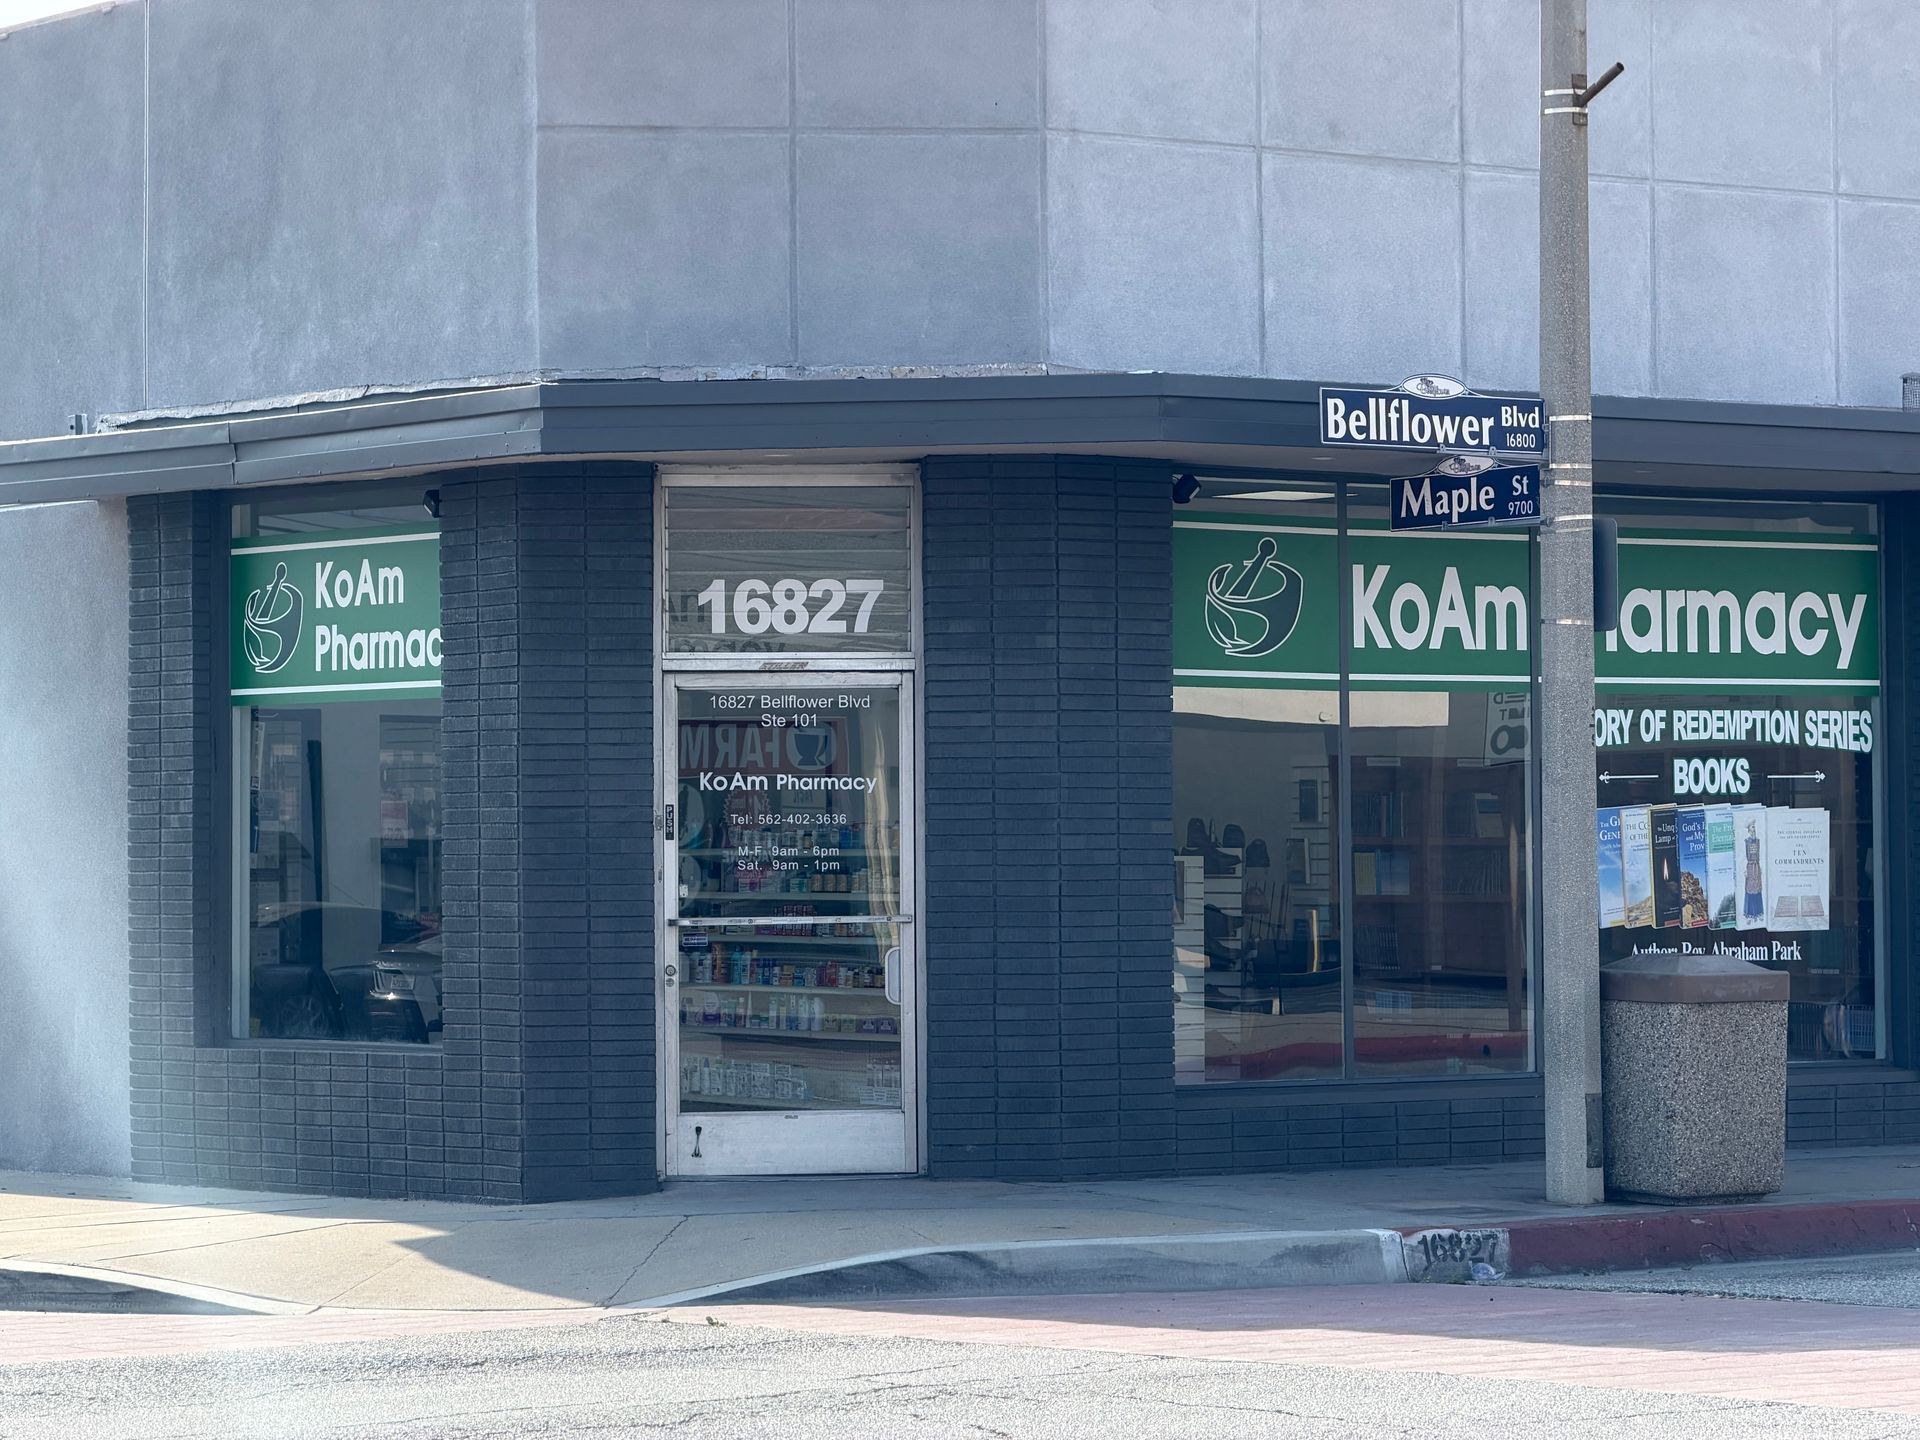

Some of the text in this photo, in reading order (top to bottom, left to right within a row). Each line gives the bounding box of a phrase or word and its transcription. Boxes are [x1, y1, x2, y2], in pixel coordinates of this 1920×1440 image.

[1327, 398, 1540, 446] Bellflower Blvd
[1506, 433, 1536, 448] 16800
[1401, 475, 1529, 523] Maple St
[1508, 501, 1533, 515] 9700
[315, 559, 404, 609] KoAm
[698, 578, 884, 635] 16827
[1352, 563, 1868, 670] KoAm armacy
[315, 624, 442, 672] Pharmac
[710, 694, 870, 709] 16827 Bellflower Blvd
[761, 713, 817, 727] Ste 101
[1640, 709, 1666, 743] OF
[1673, 709, 1799, 745] REDEMPTION
[1805, 710, 1872, 753] SERIES
[699, 771, 877, 794] KoAm Pharmacy
[1673, 758, 1750, 795] BOOKS
[730, 813, 847, 825] Tel: 562-402-3636
[1682, 822, 1701, 832] God's
[1655, 834, 1671, 845] Lamp
[738, 846, 763, 857] M-F
[772, 846, 799, 857] 9am
[812, 846, 840, 858] 6pm
[1774, 857, 1825, 865] COMMANDMENTS
[737, 860, 763, 871] Sat.
[772, 860, 799, 871] 9am
[814, 860, 840, 872] 1pm
[1712, 941, 1768, 961] Abraham
[1771, 940, 1802, 961] Park
